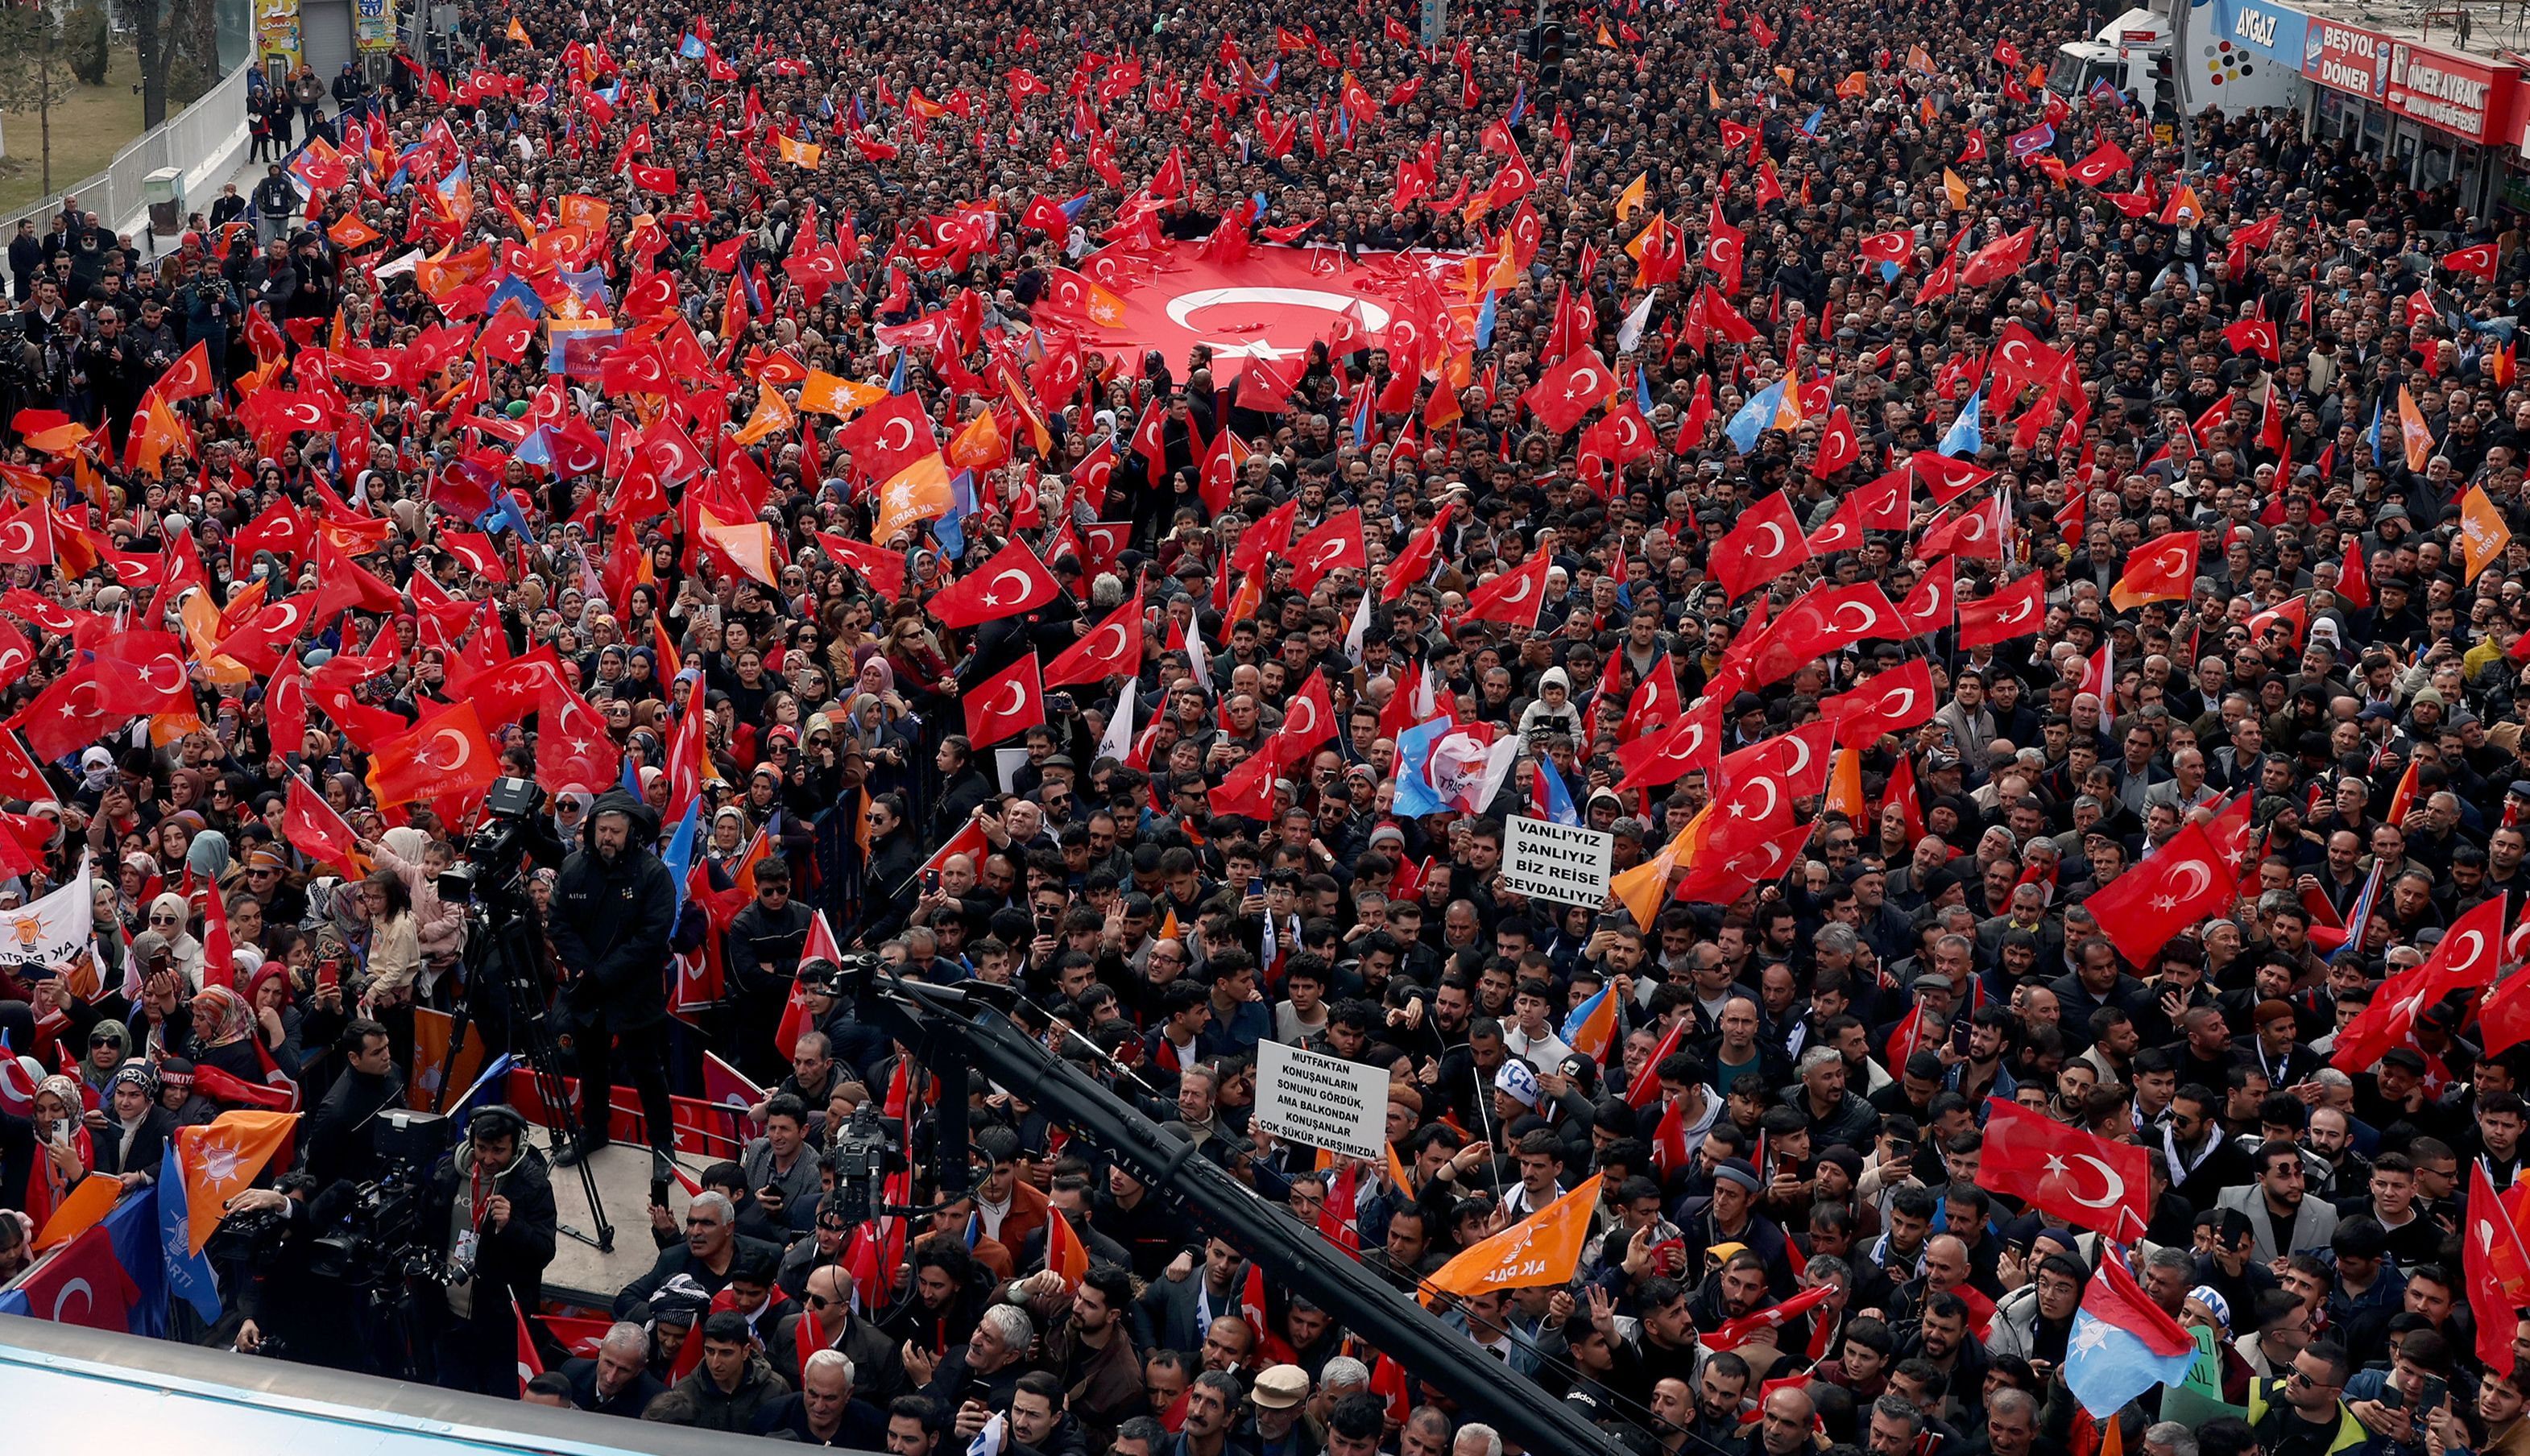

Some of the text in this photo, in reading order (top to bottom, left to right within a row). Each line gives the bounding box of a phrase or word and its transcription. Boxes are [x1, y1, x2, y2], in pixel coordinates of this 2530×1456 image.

[2235, 6, 2277, 48] AYGAZ
[2324, 27, 2375, 60] BEŞYOL
[2321, 58, 2370, 93] DÖNER
[2407, 57, 2487, 110] ÖMER AYBAK
[1517, 821, 1601, 847] VANLI'YIZ
[1517, 841, 1596, 866] ŞANLIYIZ
[1516, 859, 1600, 886] BİZ REİSE
[1504, 876, 1605, 906] SEVDALIYIZ
[1282, 1065, 1358, 1092] KONUŞANLARIN
[1292, 1052, 1350, 1075] MUTFAKTAN
[1277, 1079, 1364, 1111] SONUNU GÖRDÜK,
[1277, 1094, 1359, 1124] AMA BALKONDAN
[1260, 1119, 1377, 1159] ÇOK ŞÜKÜR KARŞIMIZDA
[1286, 1112, 1351, 1137] KONUŞANLAR
[1567, 1391, 1597, 1408] adidas
